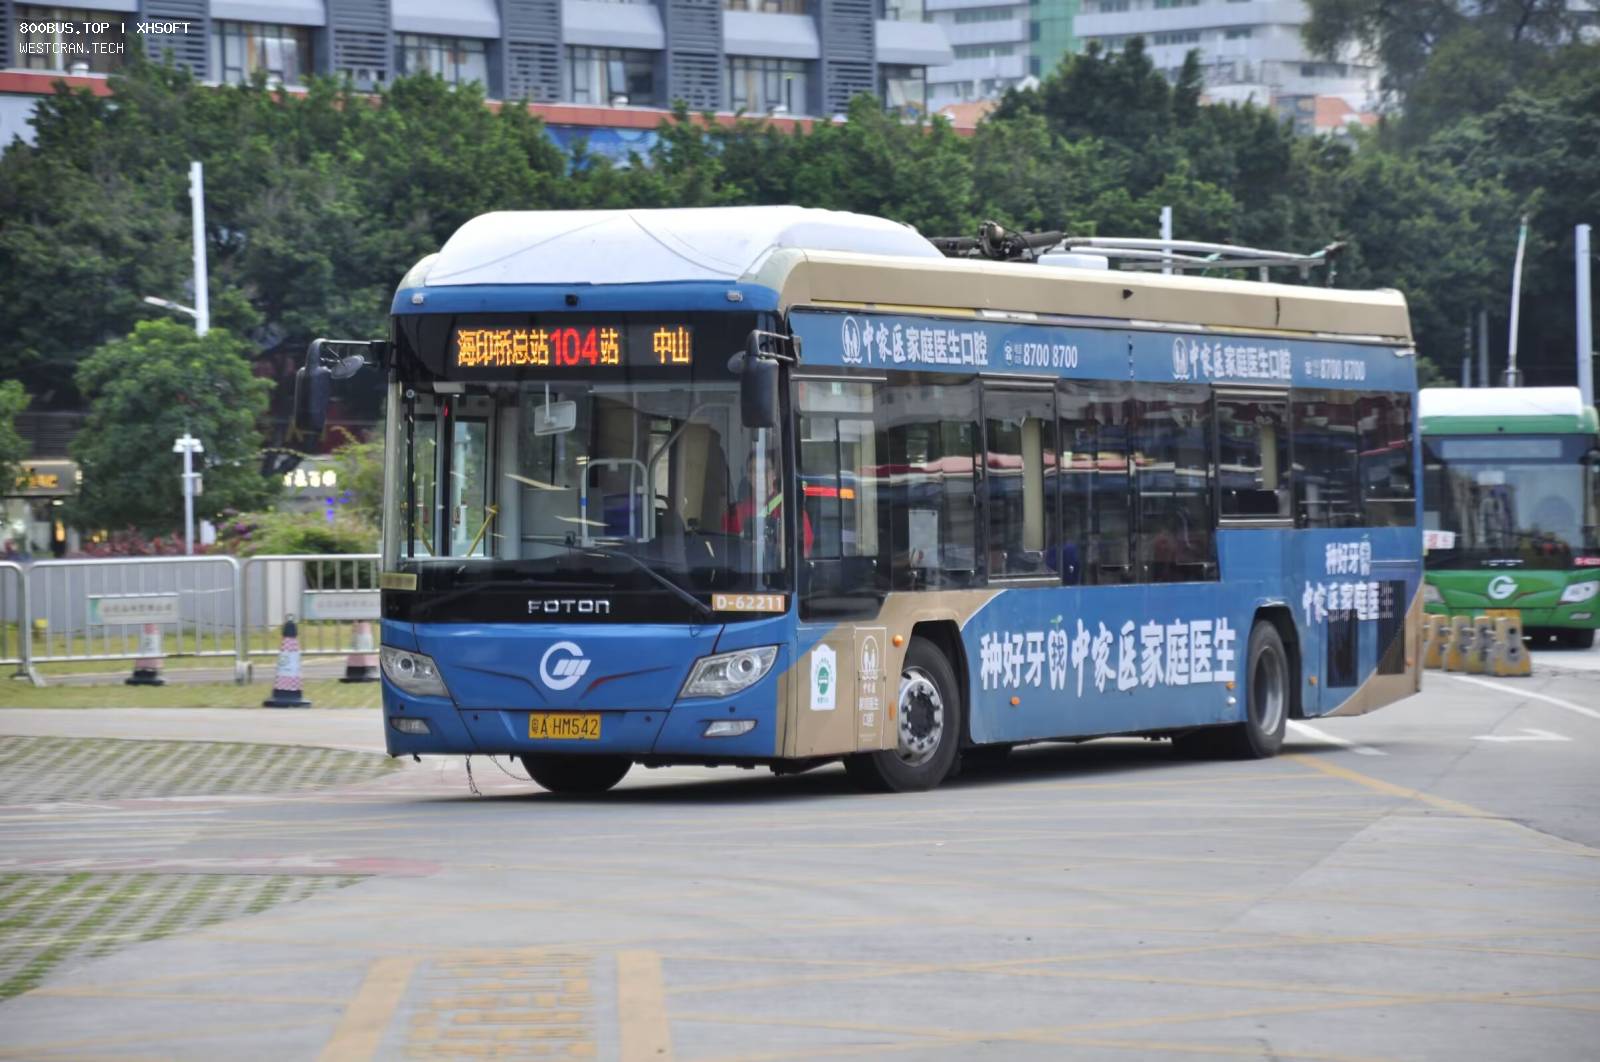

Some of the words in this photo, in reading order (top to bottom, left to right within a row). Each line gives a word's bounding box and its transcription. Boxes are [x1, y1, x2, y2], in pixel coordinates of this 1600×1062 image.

[549, 327, 599, 366] 104
[653, 326, 690, 364] 中山
[1023, 343, 1049, 367] 8700
[1052, 344, 1078, 368] 8700
[528, 599, 610, 614] FOTON
[716, 595, 783, 609] D-62211
